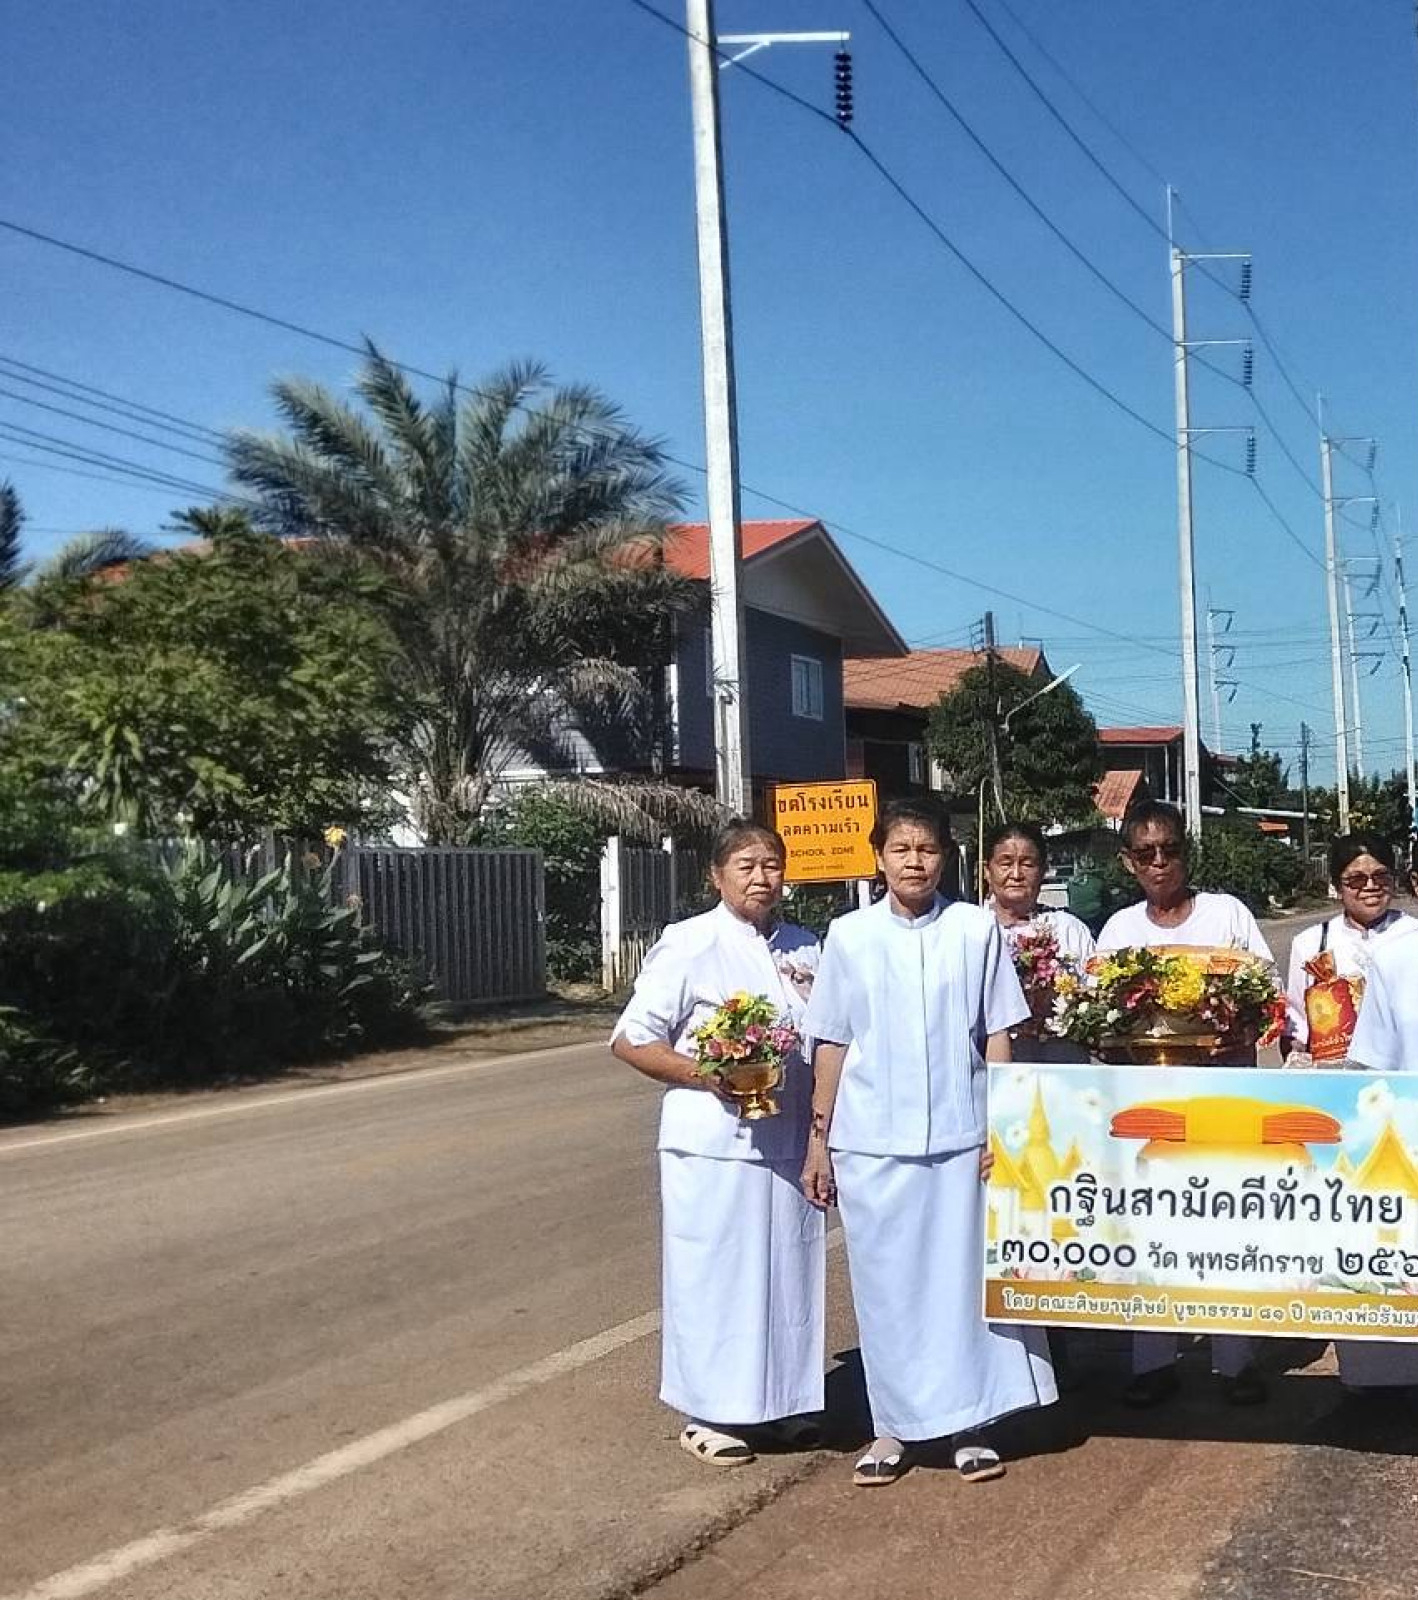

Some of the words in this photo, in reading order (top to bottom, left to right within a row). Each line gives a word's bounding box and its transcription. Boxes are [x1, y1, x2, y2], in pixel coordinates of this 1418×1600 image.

[784, 817, 860, 837] ลดความเร็ว
[790, 848, 826, 858] SCHOOL
[831, 845, 854, 855] ZONE
[1050, 1166, 1403, 1226] กฐินสามัคคีทั่วไทย
[1001, 1242, 1136, 1271] ๓๐,๐๐๐
[1148, 1243, 1178, 1271] วัด
[1187, 1246, 1324, 1281] พุทธศักราช
[1004, 1289, 1034, 1309] โดย
[1039, 1294, 1167, 1320] คณะศิษยานุศิษย์
[1173, 1303, 1253, 1322] บูชาธรรม
[1260, 1306, 1284, 1320] ๘๑
[1291, 1302, 1304, 1321] ปี
